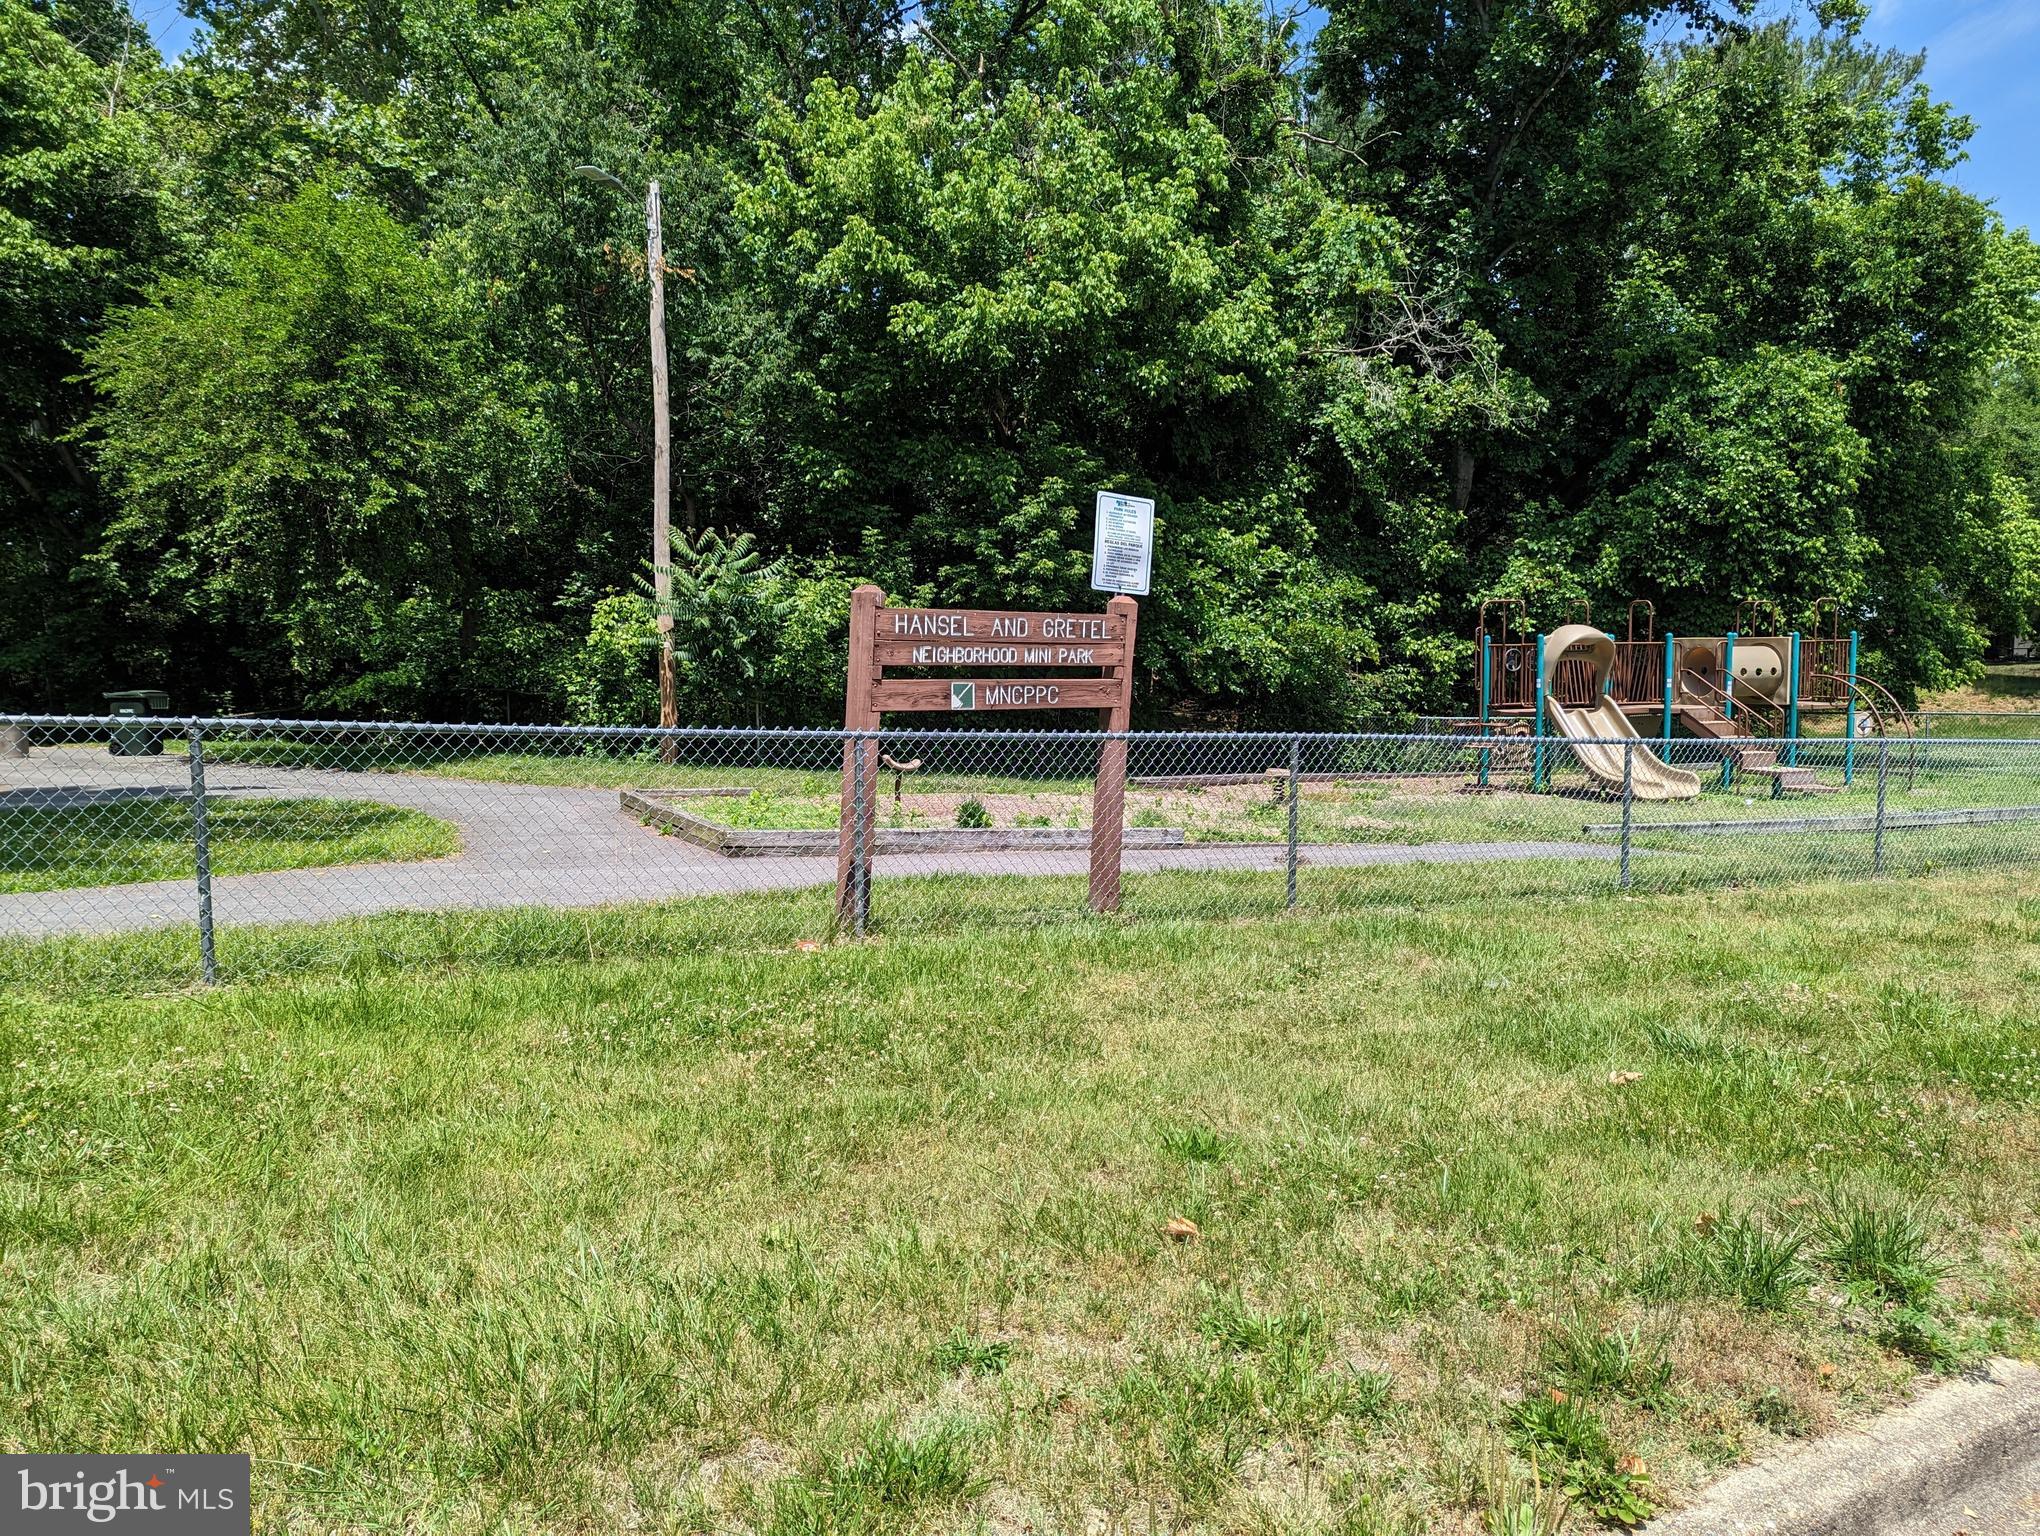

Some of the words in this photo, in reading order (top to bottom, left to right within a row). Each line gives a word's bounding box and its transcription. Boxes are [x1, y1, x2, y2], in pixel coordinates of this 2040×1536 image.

[895, 613, 975, 637] HANSEL
[991, 618, 1028, 638] AND
[1043, 618, 1112, 640] GRETEL
[912, 646, 1017, 664] NEIGHBORHOOD
[1024, 647, 1052, 663] MINI
[1059, 648, 1094, 664] PARK
[985, 685, 1060, 706] MNCPPC
